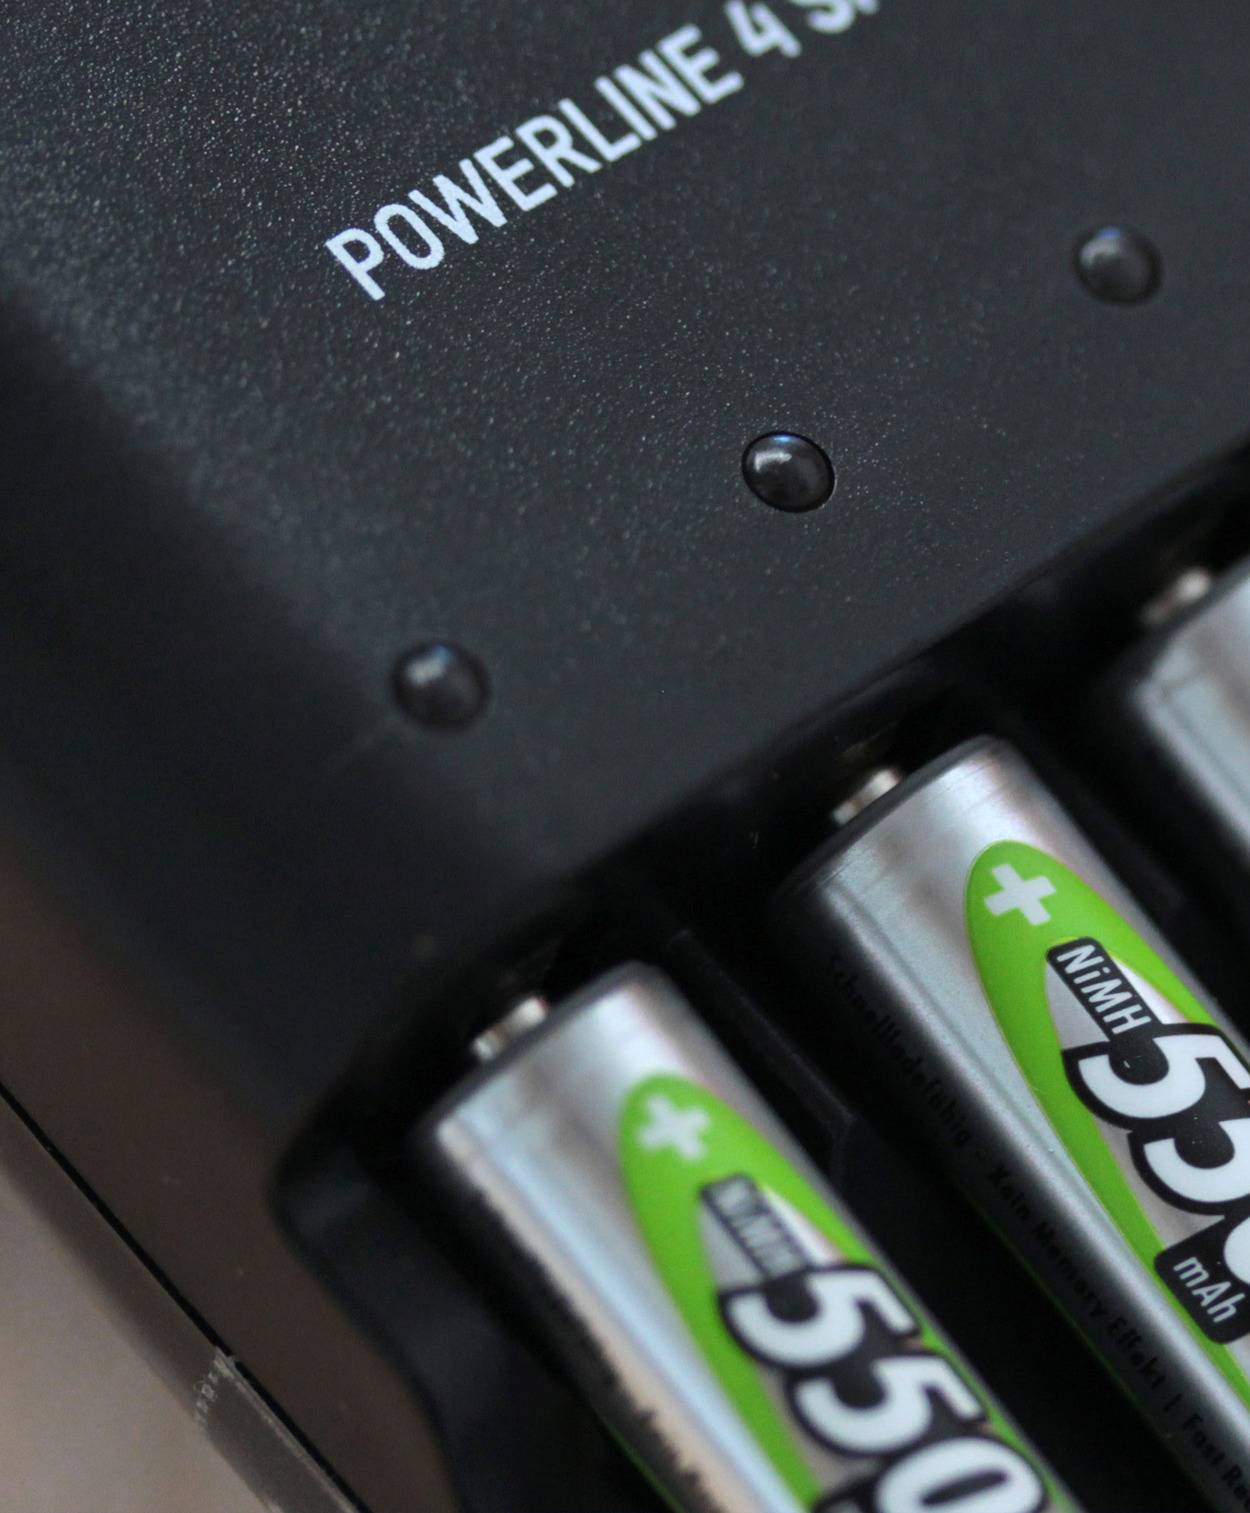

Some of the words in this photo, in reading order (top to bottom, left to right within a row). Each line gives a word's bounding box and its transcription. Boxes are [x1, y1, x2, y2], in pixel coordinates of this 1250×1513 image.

[325, 23, 743, 300] POWERLINE
[725, 0, 801, 58] 4
[1056, 942, 1151, 1035] NiMH
[1172, 1255, 1246, 1325] mAh
[722, 1266, 1046, 1513] 550
